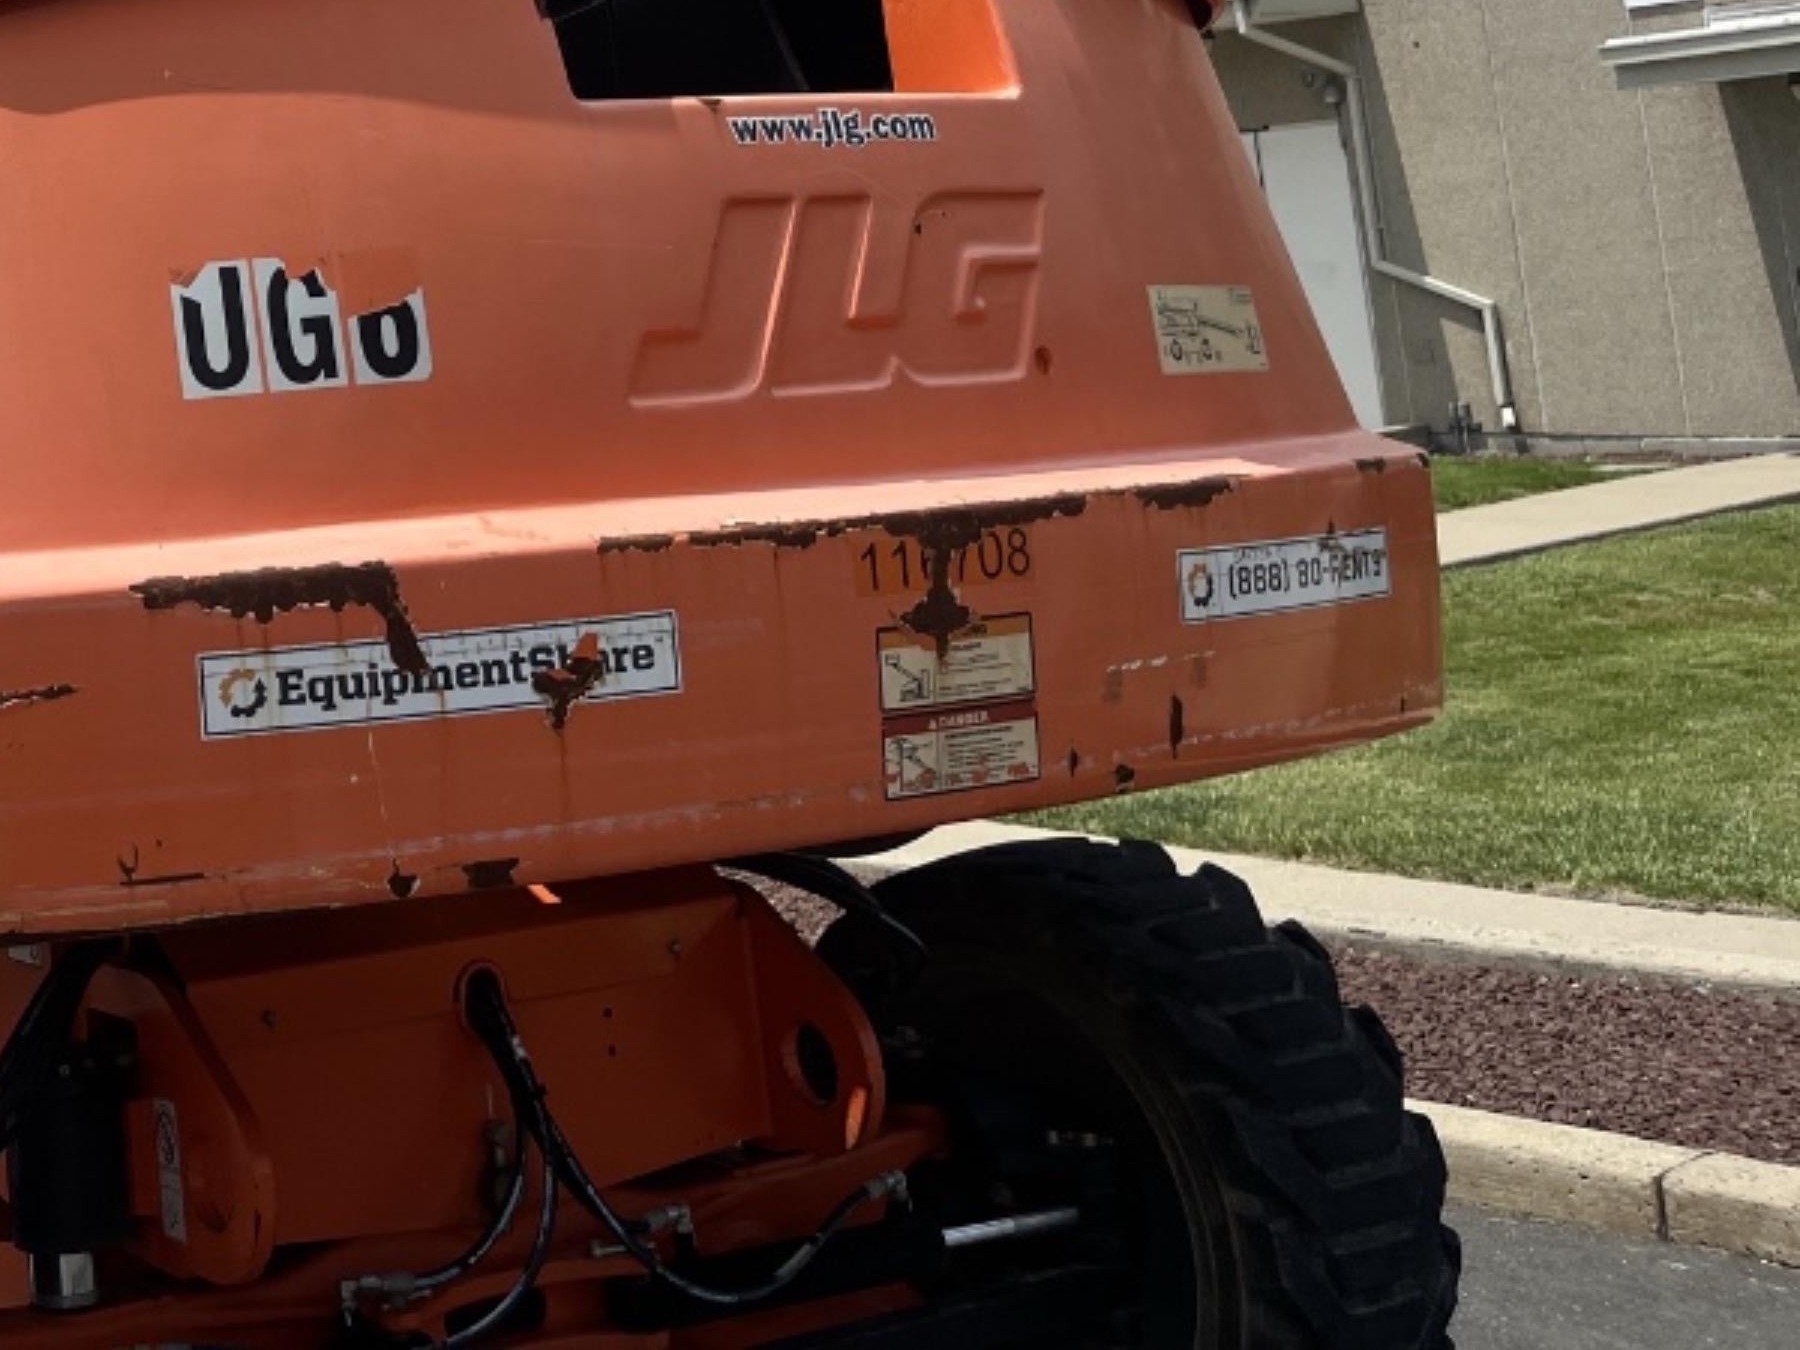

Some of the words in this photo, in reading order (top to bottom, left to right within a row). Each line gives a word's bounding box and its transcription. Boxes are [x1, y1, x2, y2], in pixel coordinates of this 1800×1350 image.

[727, 107, 936, 148] www.jlg.com
[626, 188, 1045, 408] JLG
[860, 527, 1030, 592] 1108
[1229, 558, 1290, 600] (888)
[276, 642, 656, 712] EquipmentSre
